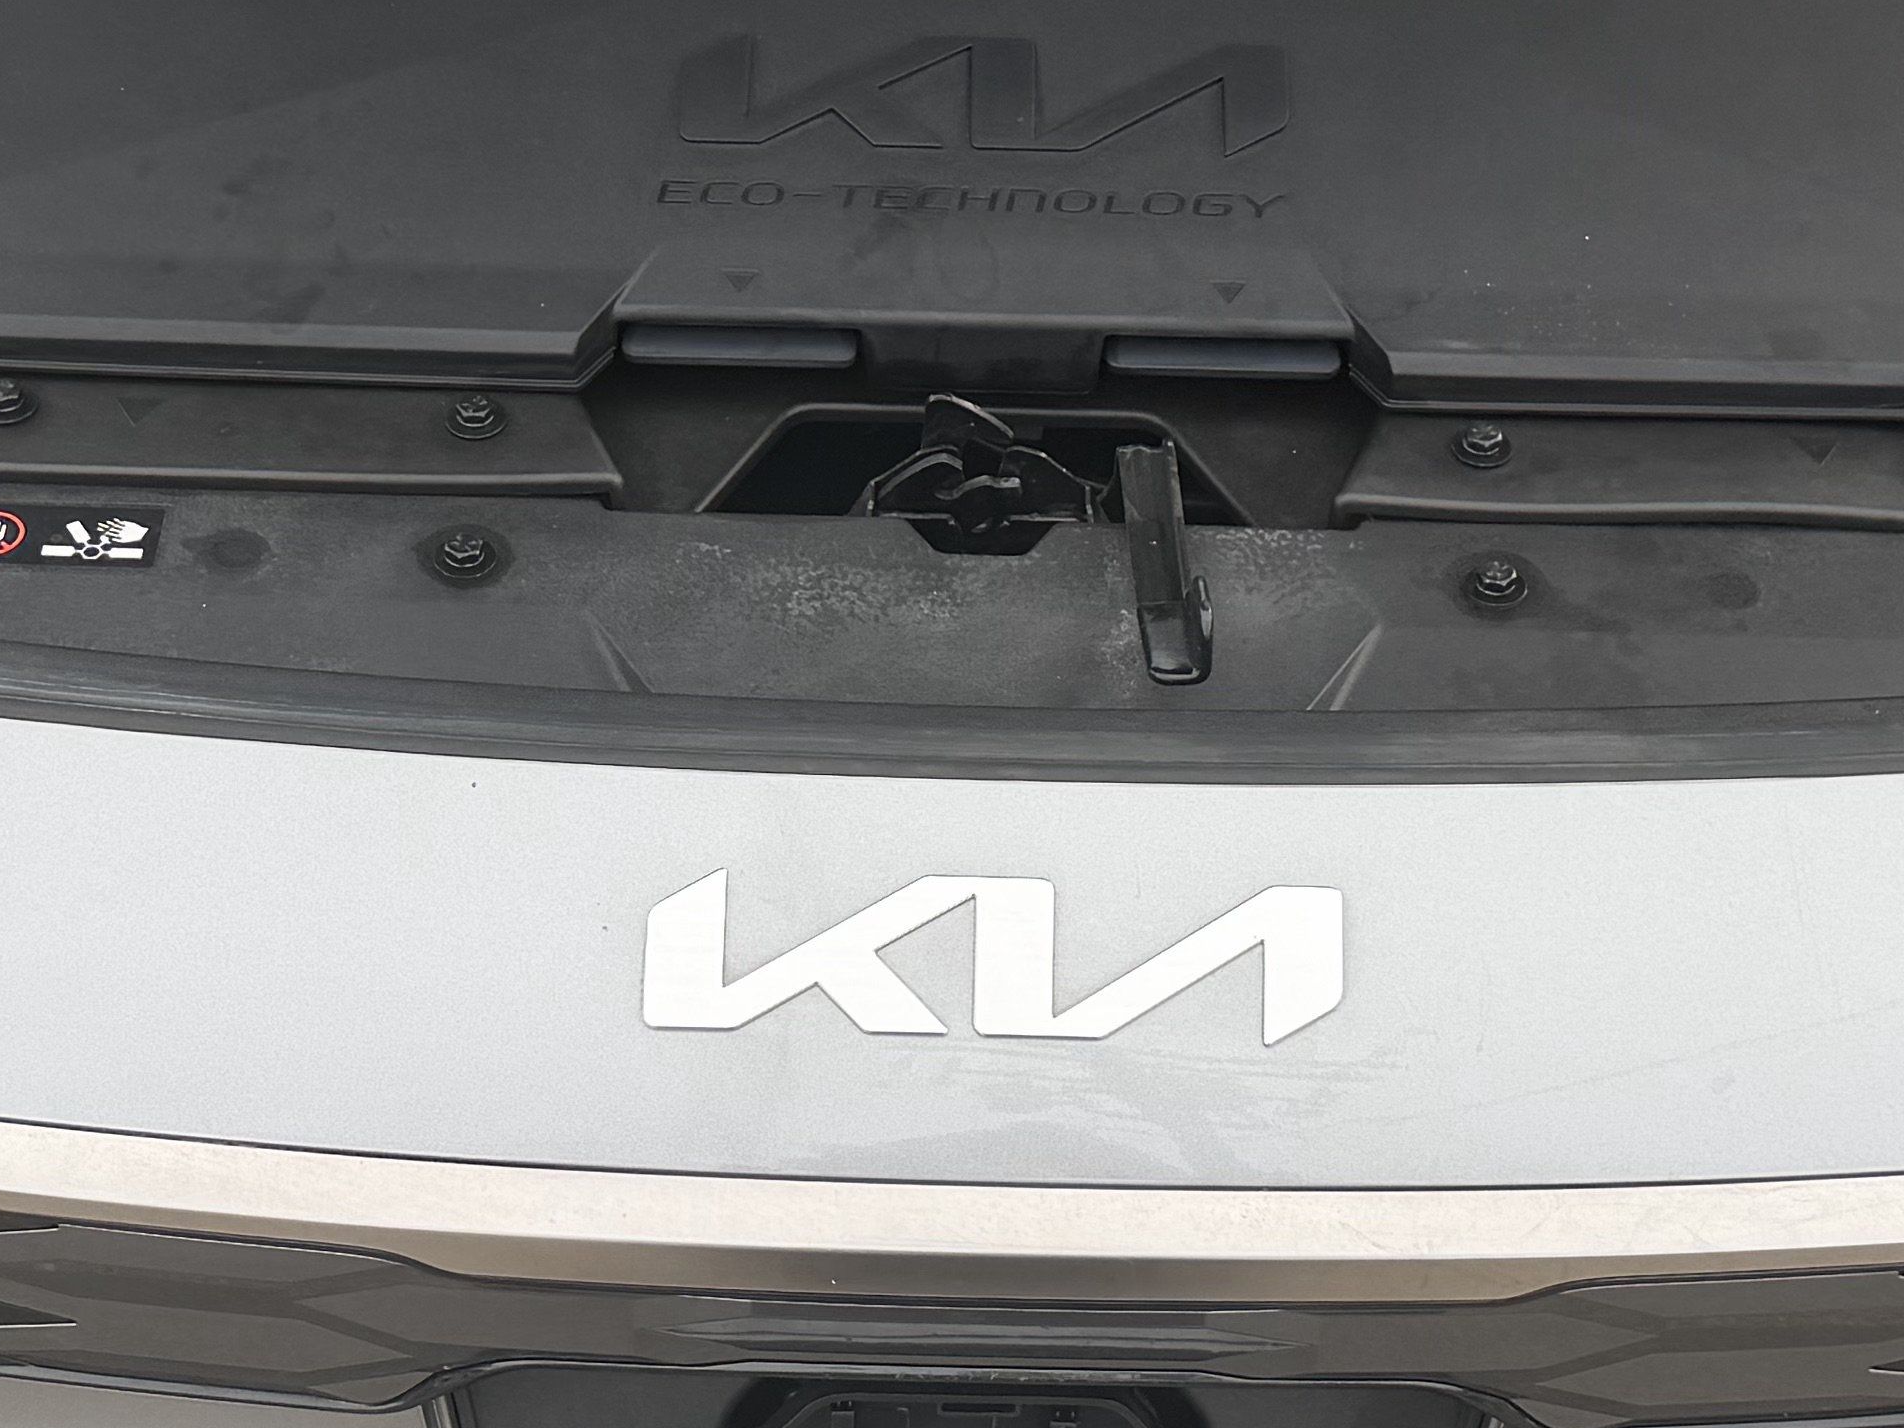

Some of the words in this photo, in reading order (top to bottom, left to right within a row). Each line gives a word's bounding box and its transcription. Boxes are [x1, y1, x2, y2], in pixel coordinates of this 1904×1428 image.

[678, 34, 1292, 158] KIA
[656, 178, 1288, 221] ECO-TECHNOLOGY
[643, 867, 1344, 1047] KIA
